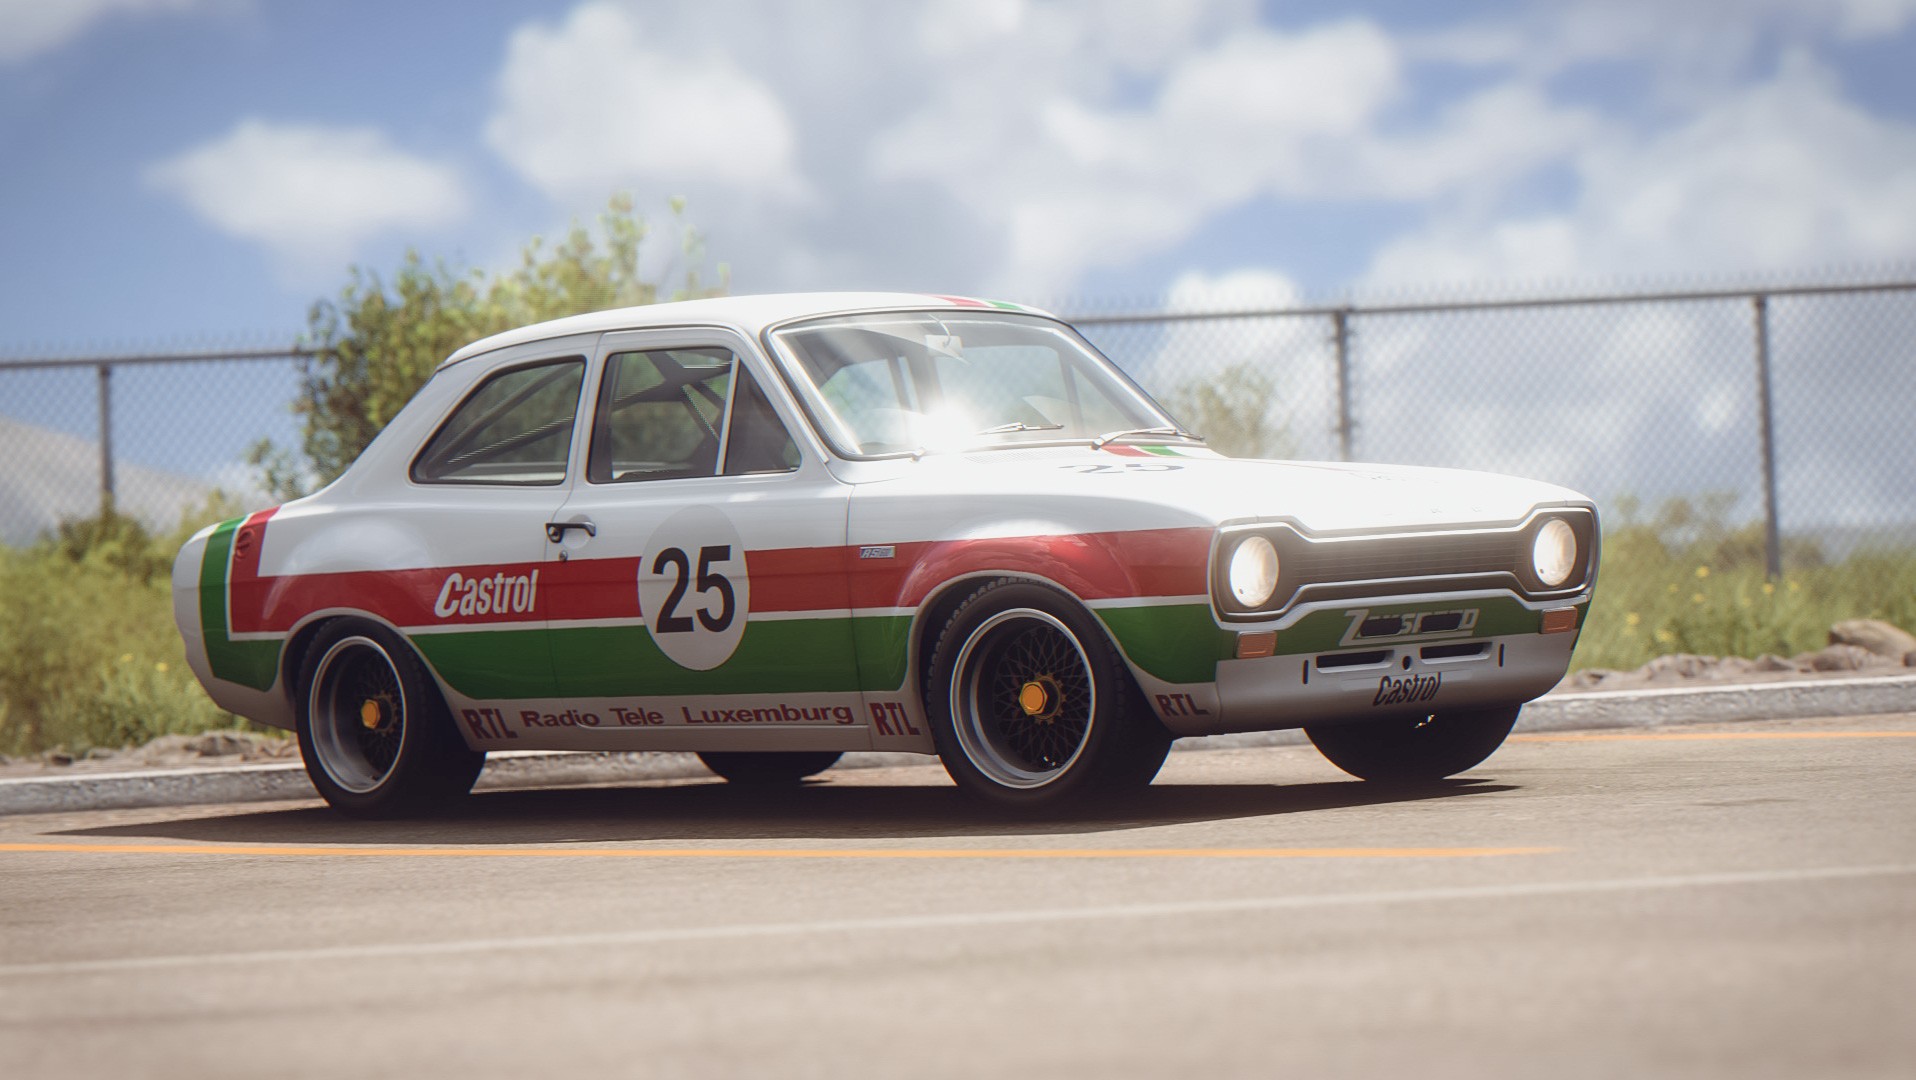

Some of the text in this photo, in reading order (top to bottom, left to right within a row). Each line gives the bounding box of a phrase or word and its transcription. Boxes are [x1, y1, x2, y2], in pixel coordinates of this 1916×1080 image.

[434, 569, 539, 618] Castrol
[652, 544, 735, 634] 25
[1155, 693, 1212, 718] RTL
[1372, 671, 1442, 706] Castrol
[462, 704, 855, 740] RTL Radio Tele Luxemburg
[869, 702, 921, 736] RTL
